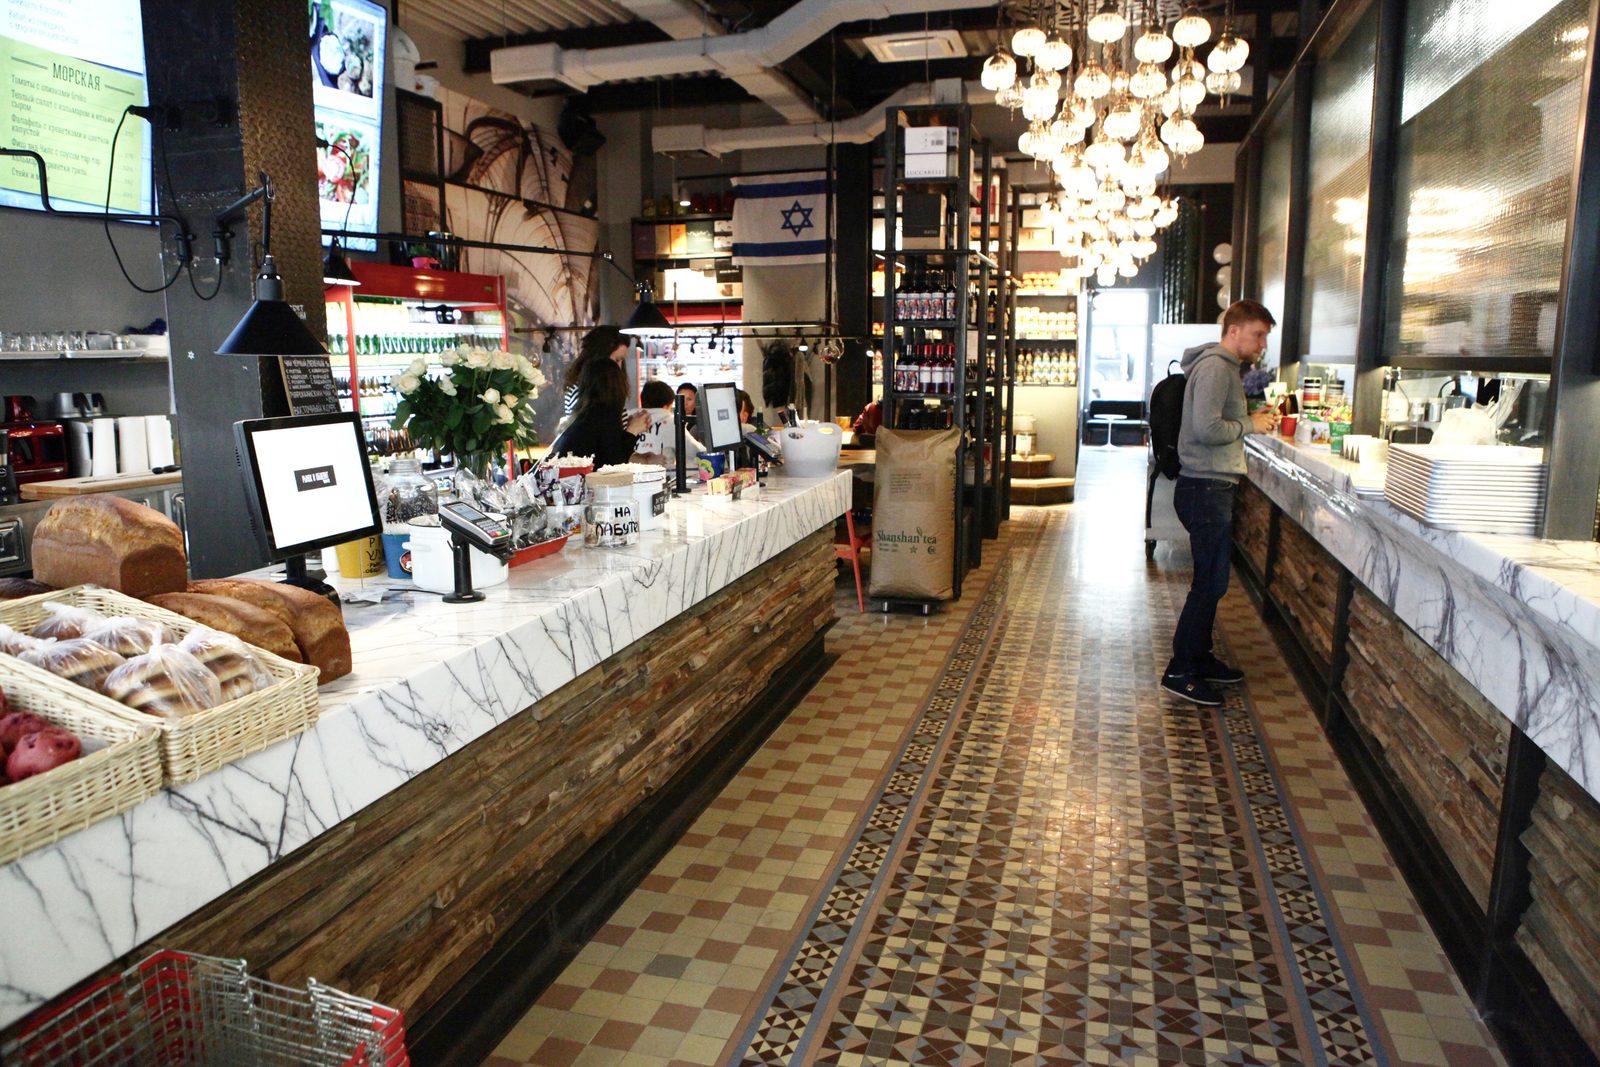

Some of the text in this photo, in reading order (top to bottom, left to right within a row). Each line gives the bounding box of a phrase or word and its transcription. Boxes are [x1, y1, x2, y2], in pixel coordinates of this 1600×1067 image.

[53, 62, 101, 91] МОРСКАЯ
[614, 506, 631, 518] НА
[877, 529, 937, 545] Shanshan tea
